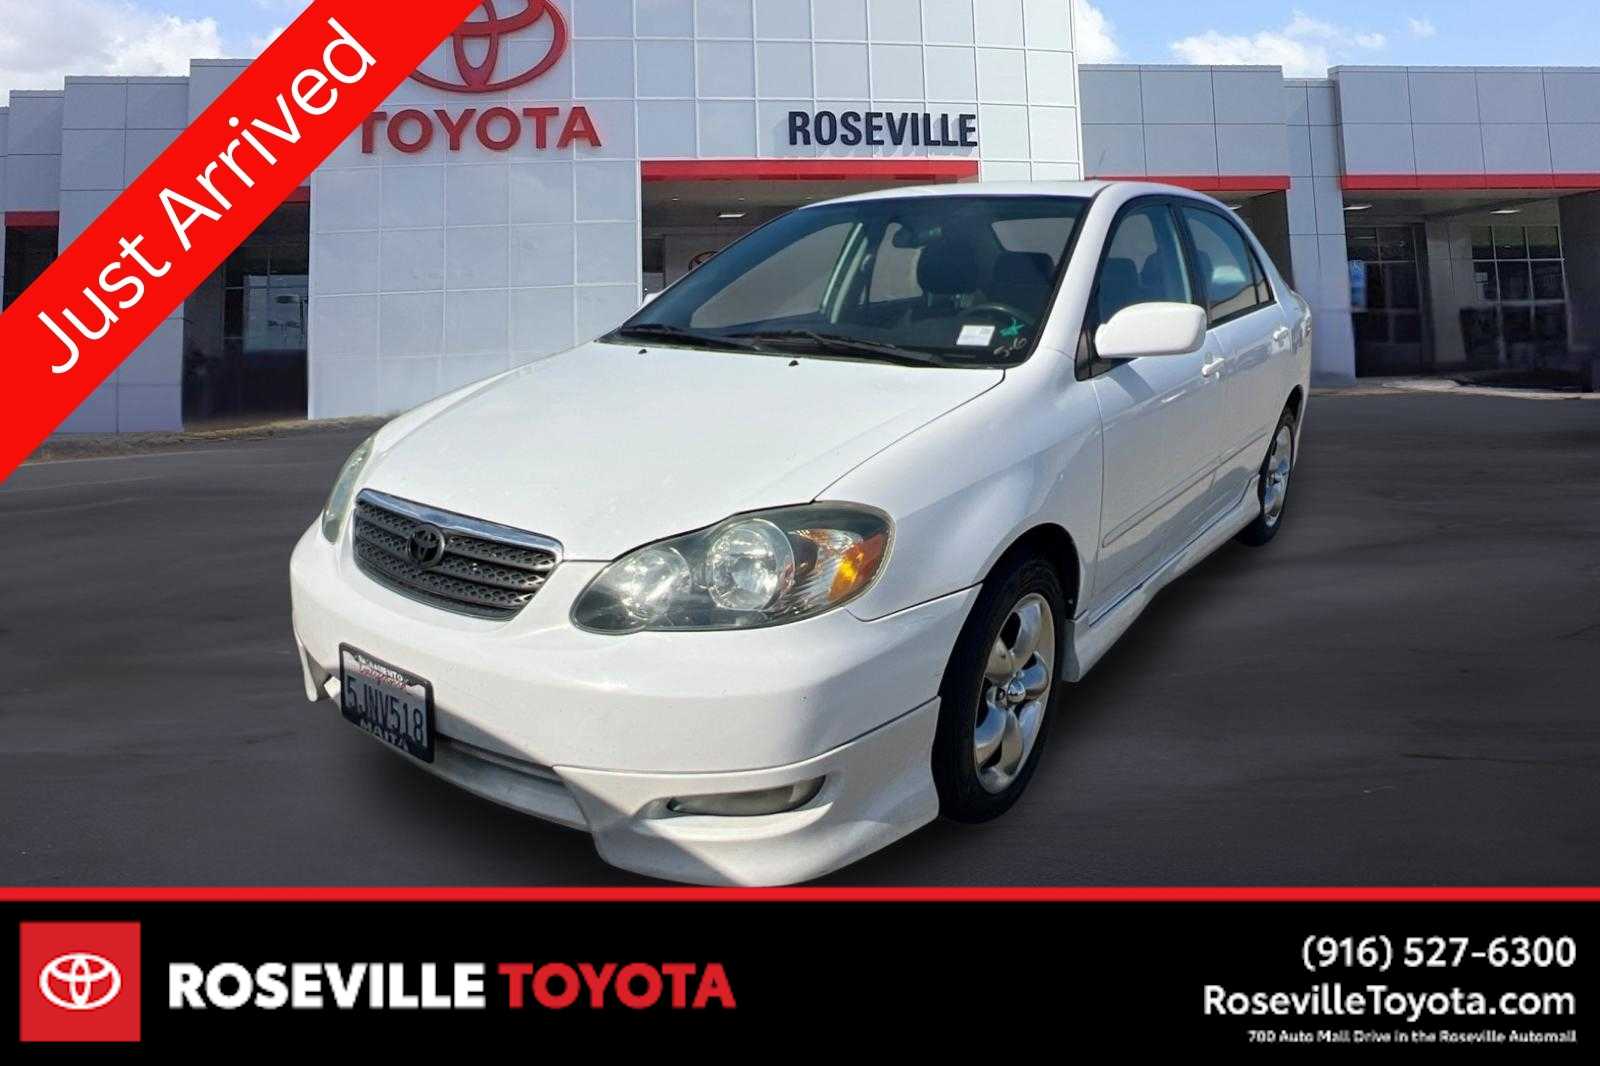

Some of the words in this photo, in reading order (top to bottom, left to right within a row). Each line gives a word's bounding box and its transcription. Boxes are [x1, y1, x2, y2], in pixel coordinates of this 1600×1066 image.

[361, 106, 602, 153] TOYOTA
[788, 110, 978, 147] ROSEVILLE
[345, 675, 424, 742] 5JNV518
